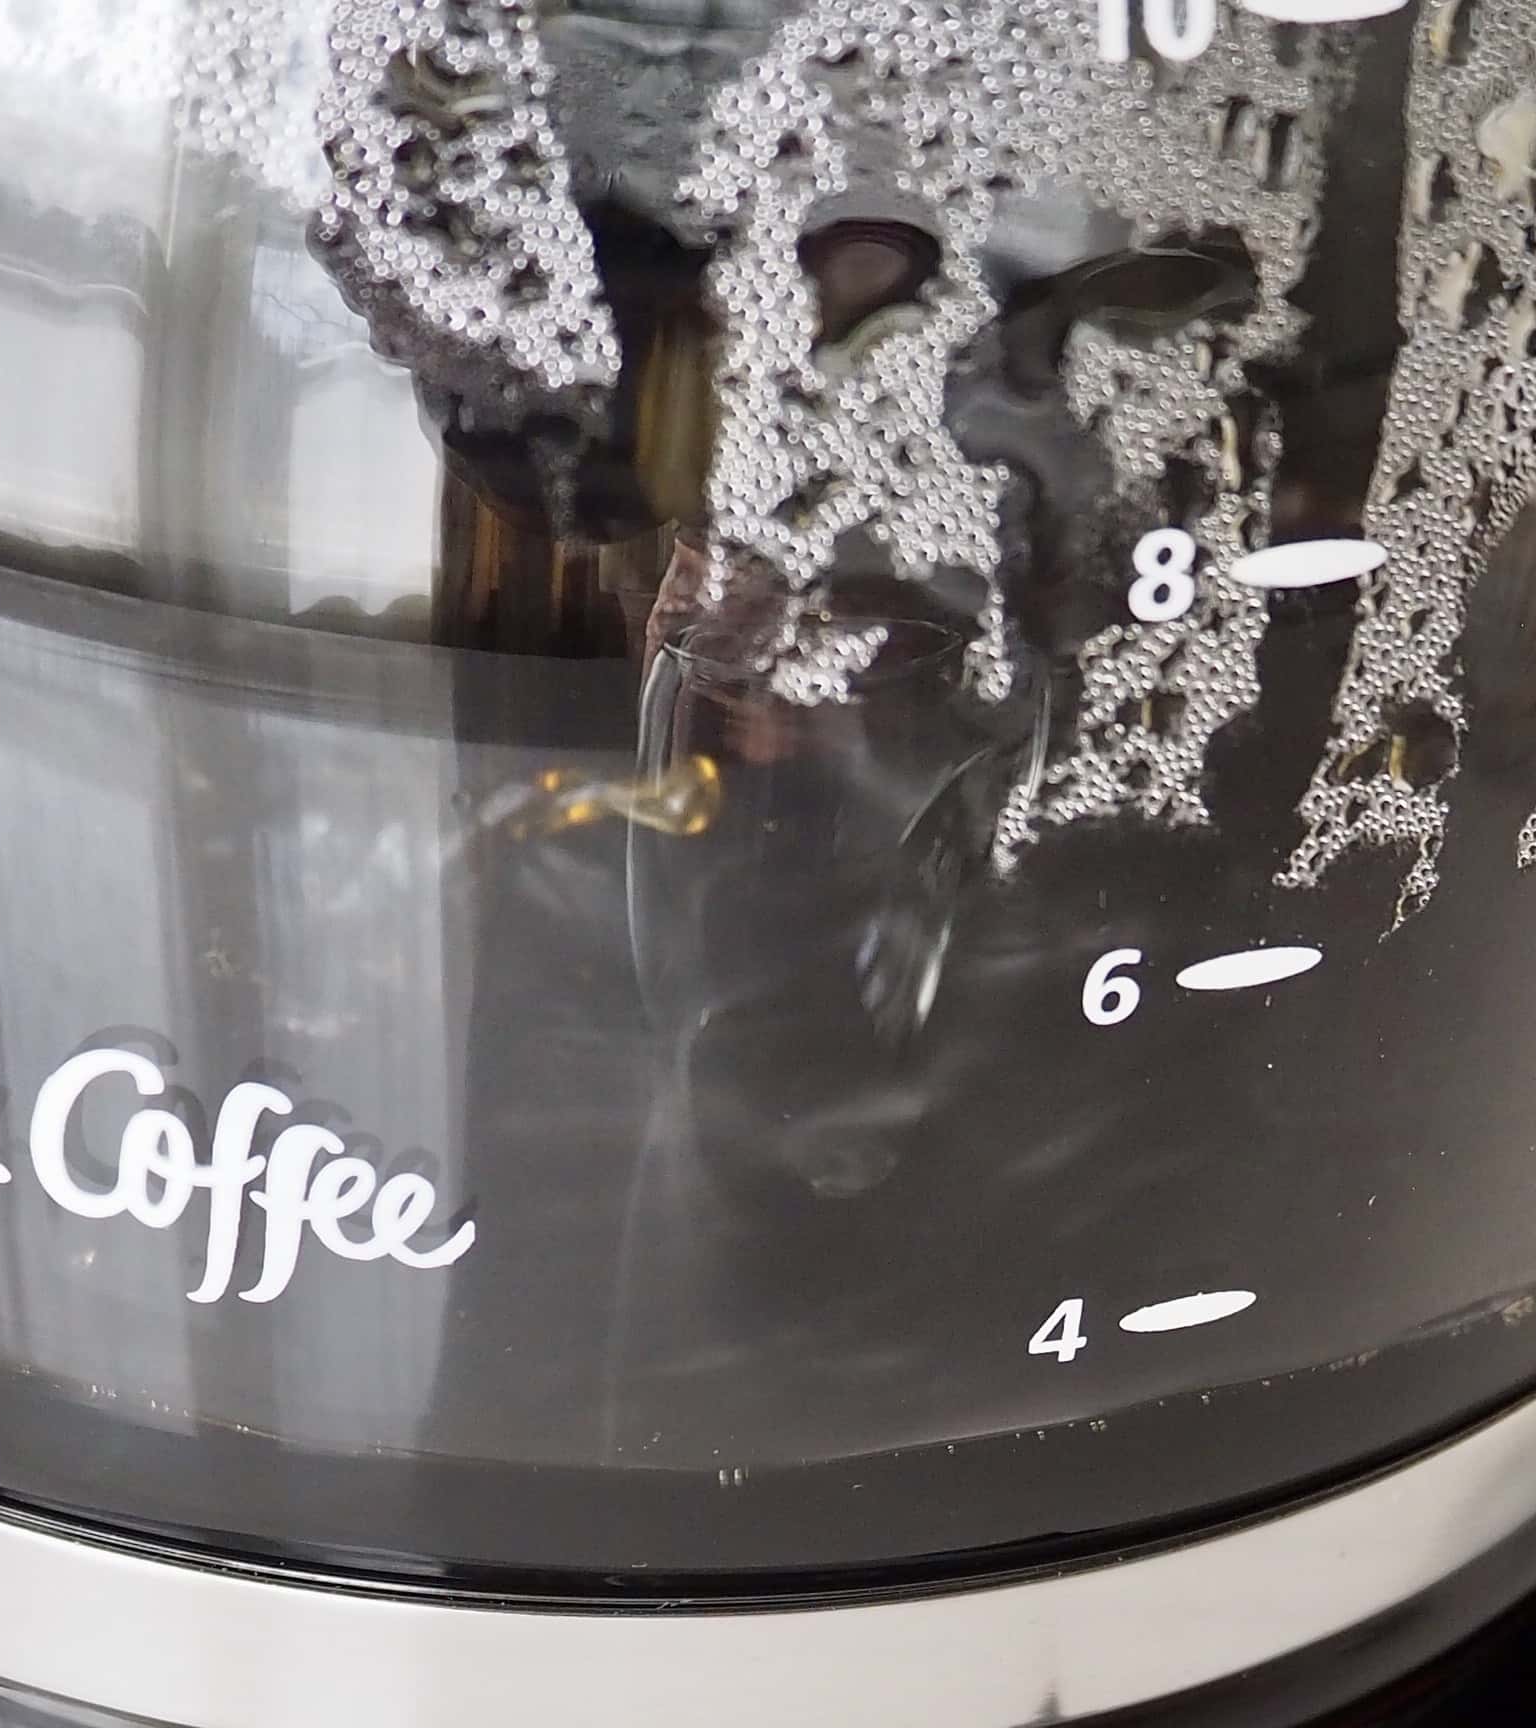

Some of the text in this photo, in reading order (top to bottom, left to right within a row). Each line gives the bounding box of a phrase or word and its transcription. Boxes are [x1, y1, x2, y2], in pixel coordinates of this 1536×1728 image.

[1097, 0, 1214, 62] 10
[1128, 528, 1196, 622] 8
[1082, 948, 1142, 1026] 6
[28, 1047, 476, 1304] Coffee
[1028, 1298, 1087, 1362] 4
